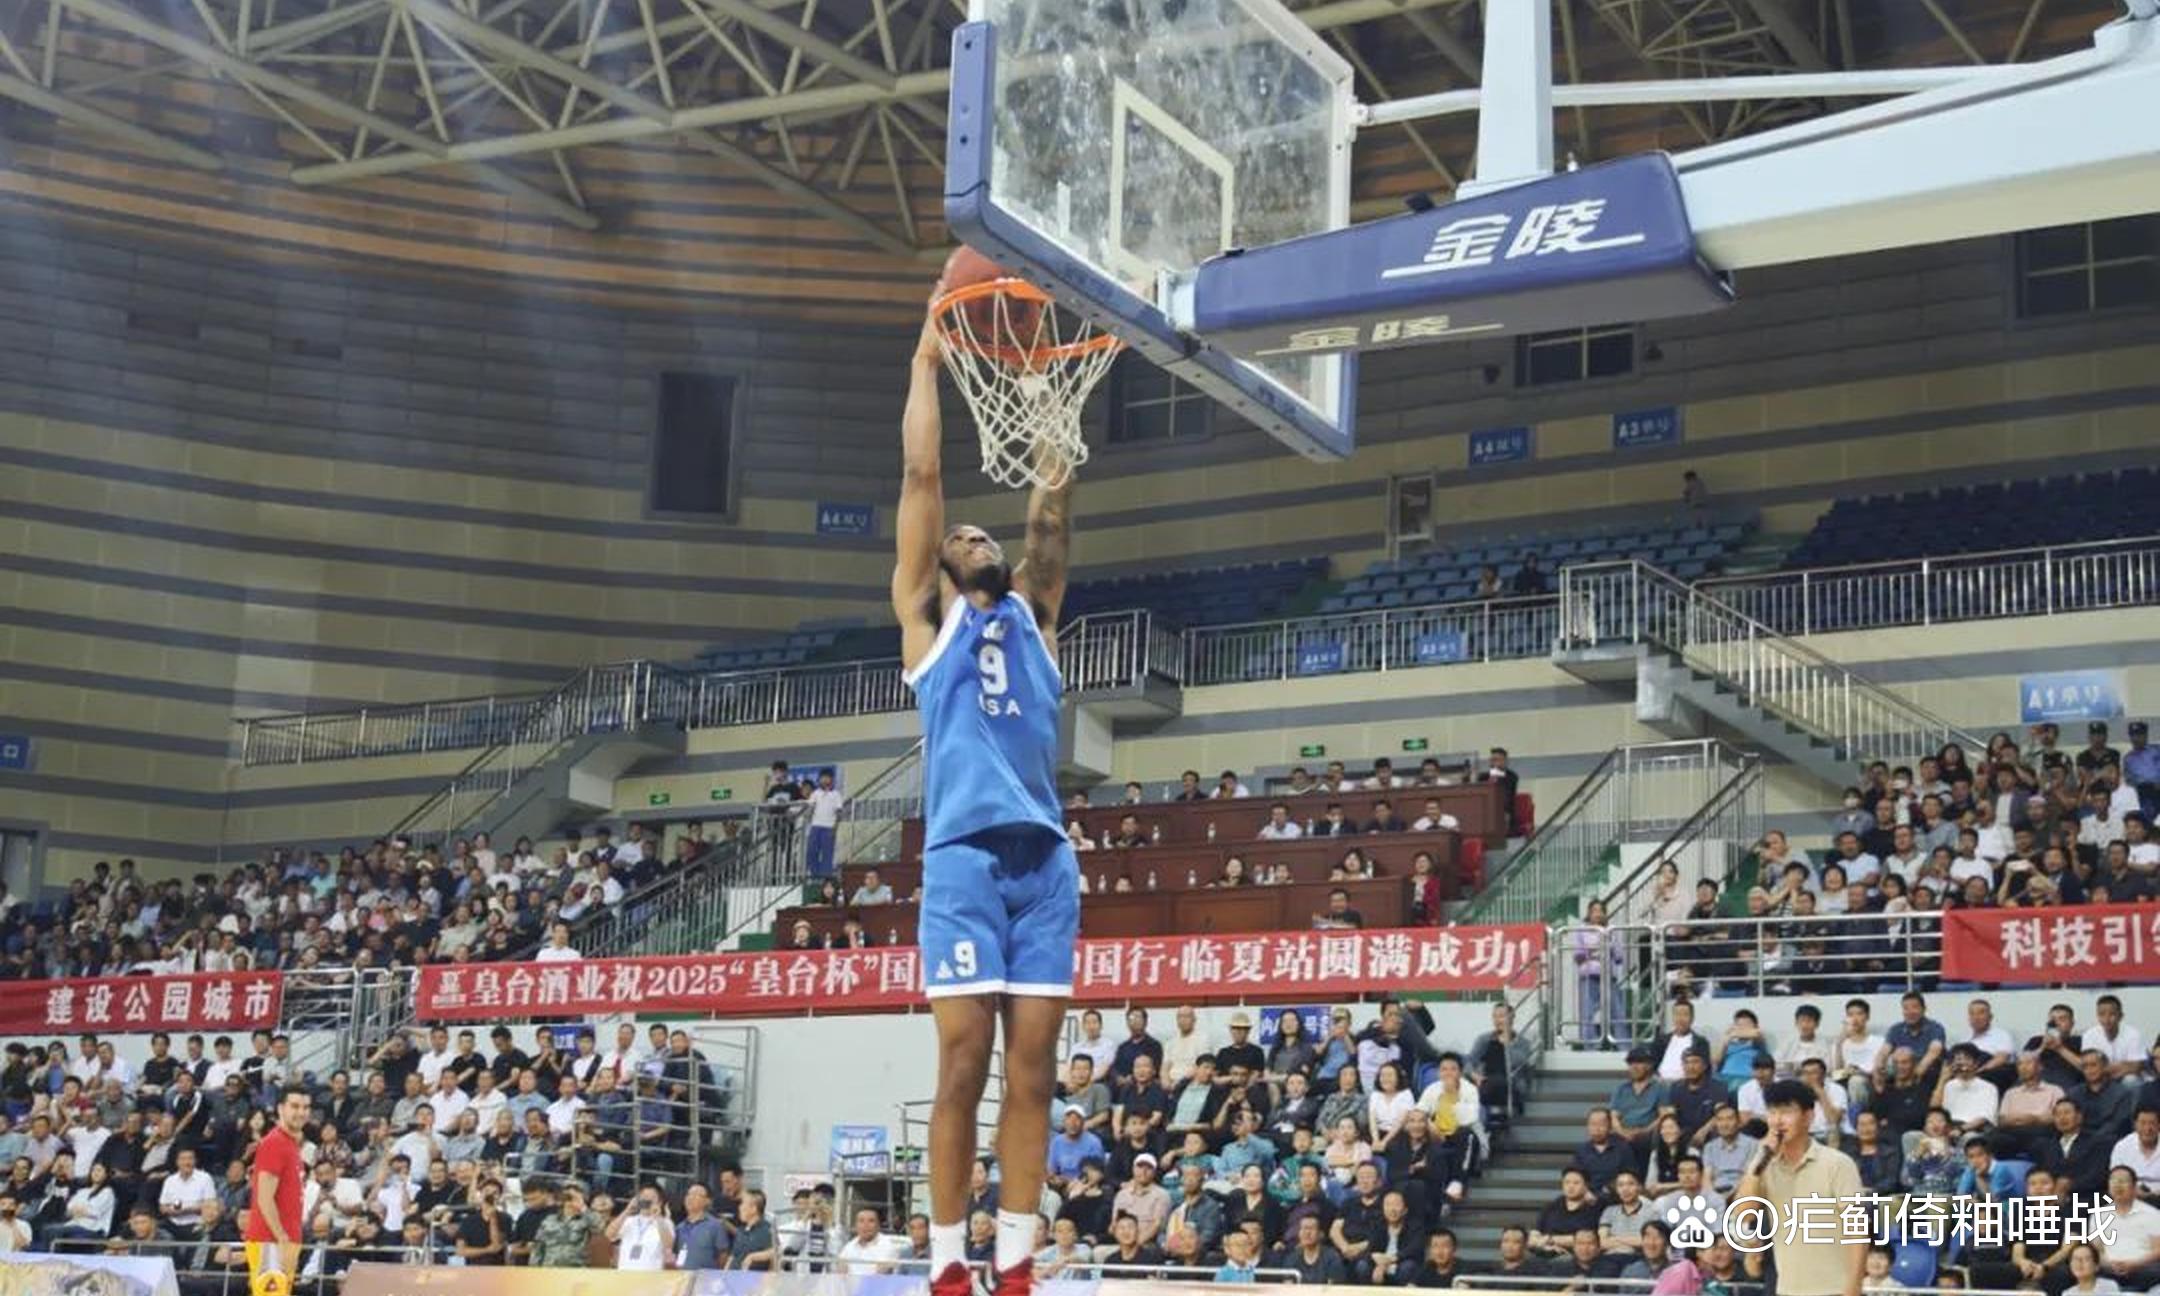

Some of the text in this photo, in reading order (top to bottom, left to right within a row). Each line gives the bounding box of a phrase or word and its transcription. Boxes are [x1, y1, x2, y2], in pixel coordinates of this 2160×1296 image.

[1382, 199, 1645, 278] 金陵
[979, 643, 1009, 695] 9
[954, 940, 977, 977] 9
[2001, 912, 2160, 970] 科技引
[45, 978, 274, 1025] 建设公园城市
